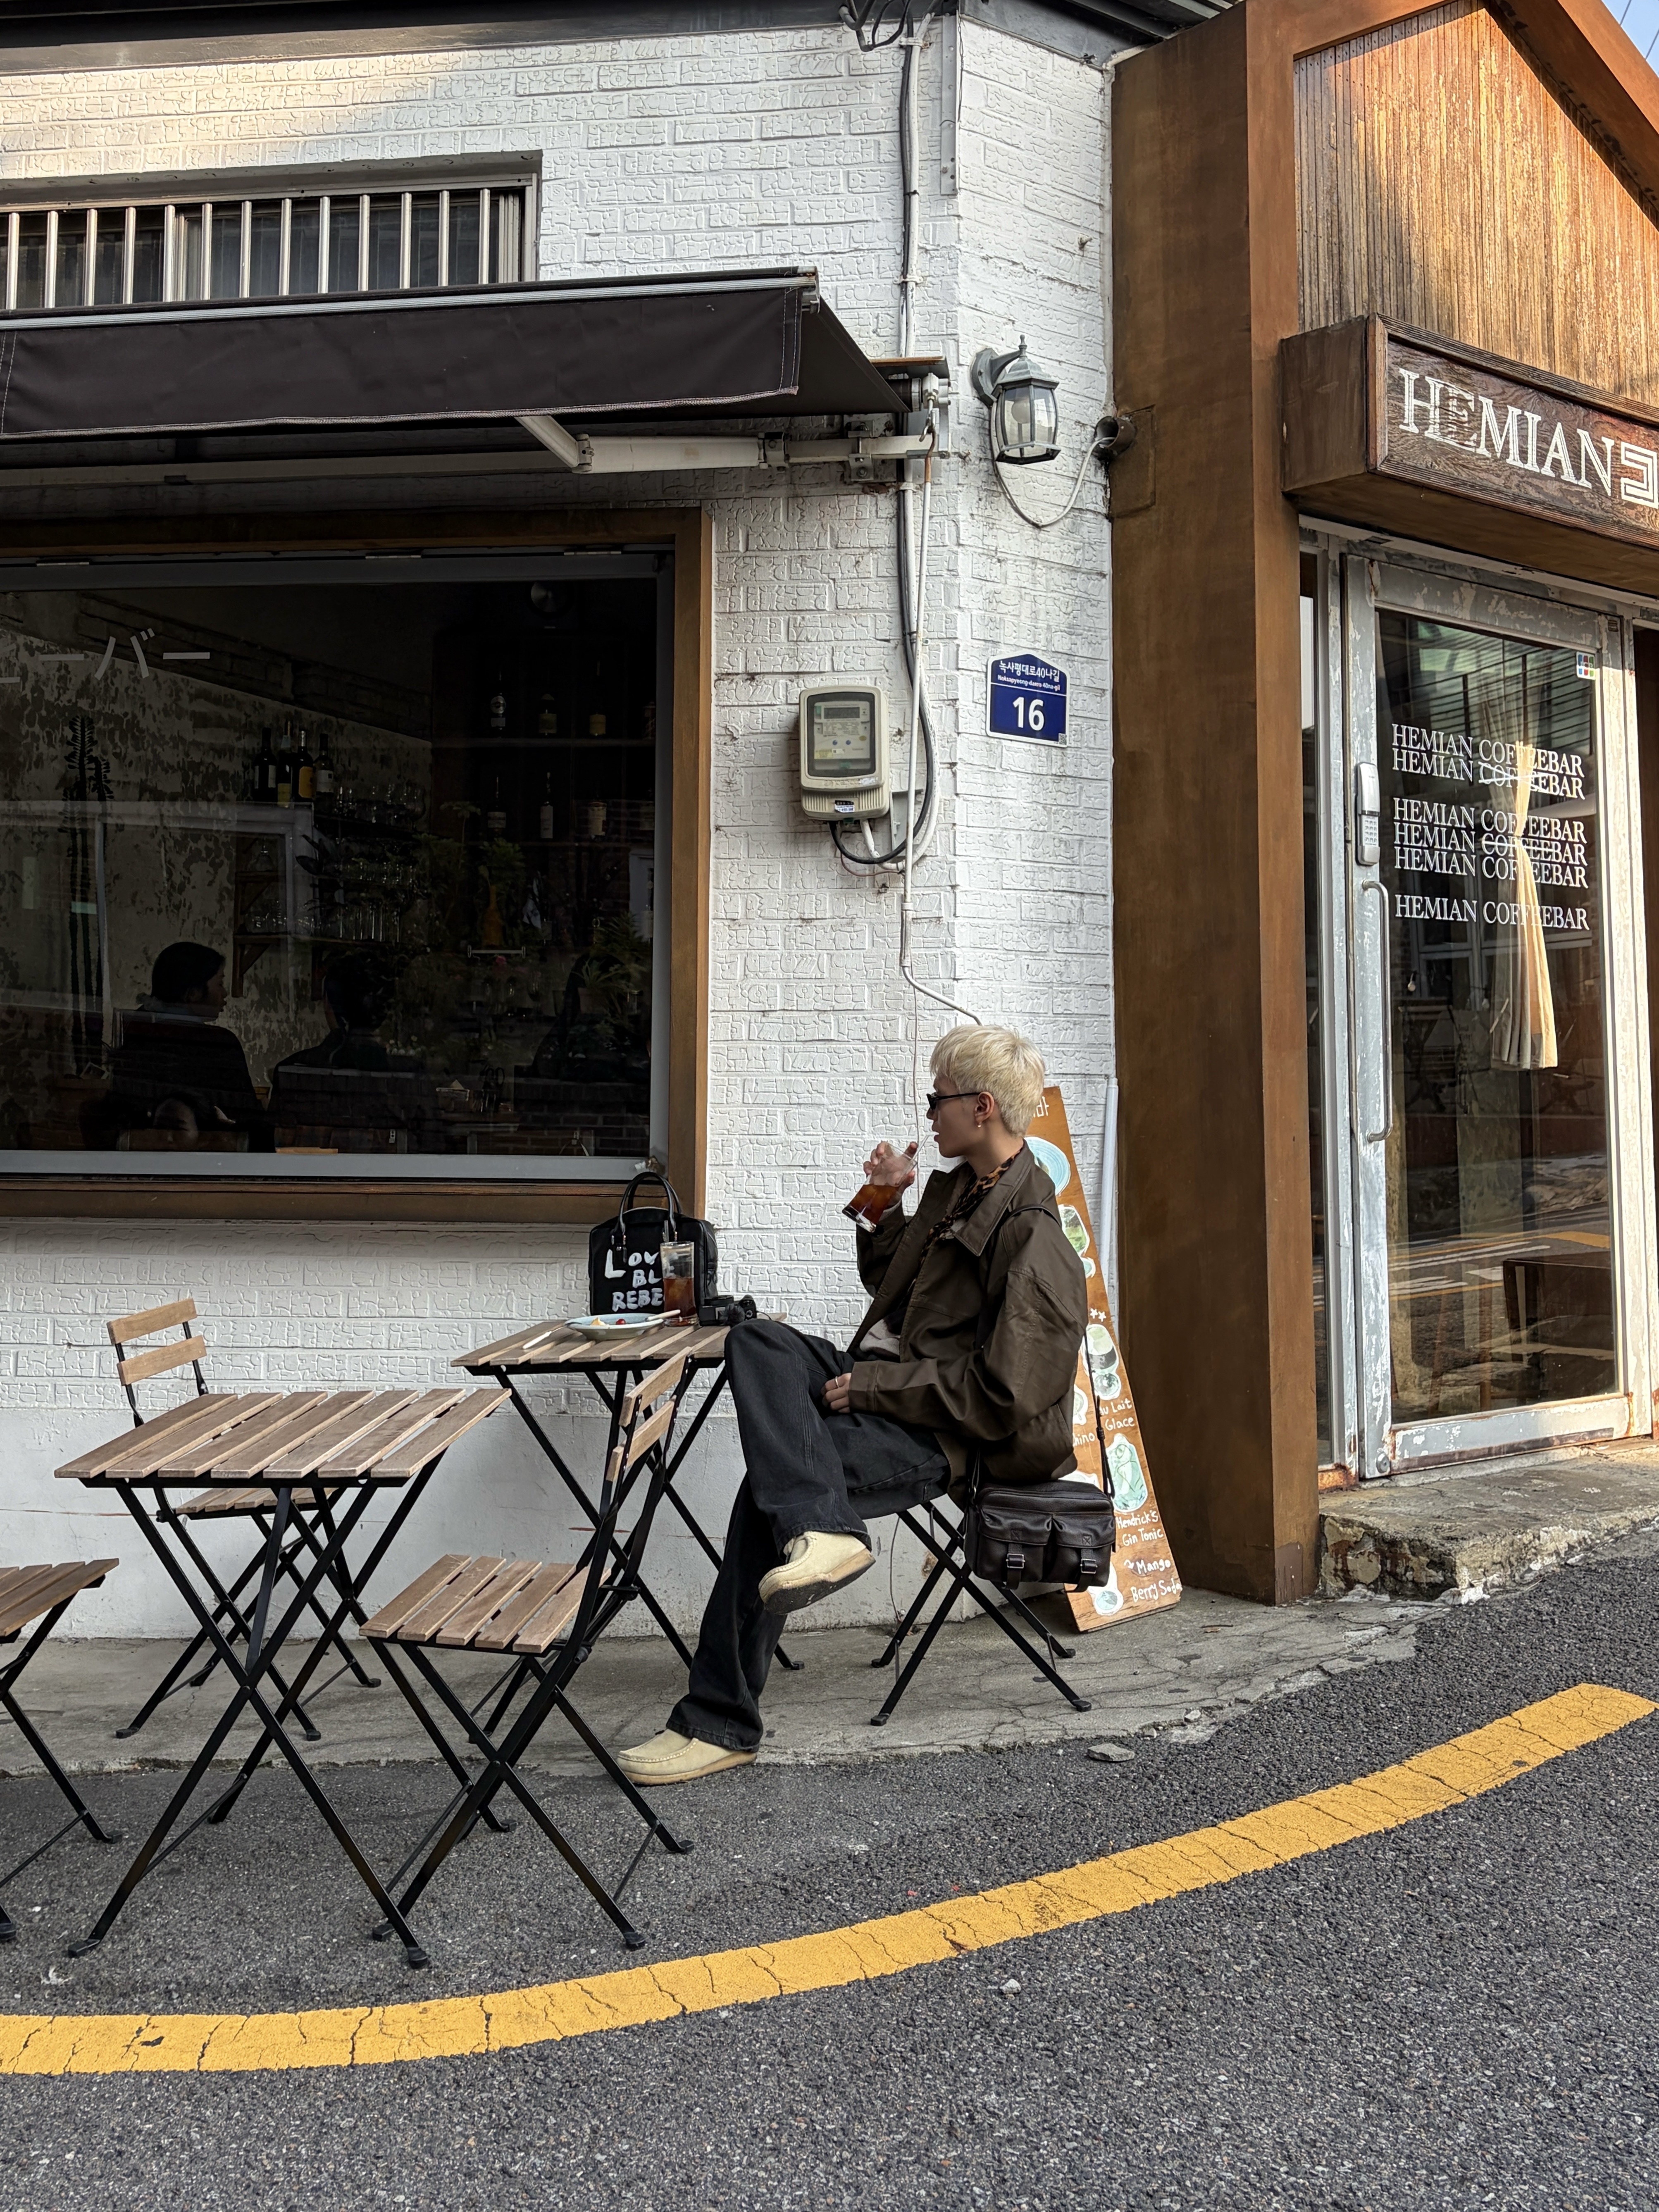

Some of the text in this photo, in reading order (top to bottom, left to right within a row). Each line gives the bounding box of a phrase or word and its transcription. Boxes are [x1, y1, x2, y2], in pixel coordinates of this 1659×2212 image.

[1399, 368, 1614, 496] HEMIAN
[999, 660, 1060, 682] 녹사평대로40나길
[1012, 696, 1044, 731] 16
[1391, 723, 1473, 759] HEMIAN
[1392, 748, 1585, 800] HEMIAN COFEEBAR
[1393, 797, 1587, 844] HEMIAN COFEEBAR
[1393, 822, 1475, 853] HEMIAN
[1394, 846, 1589, 889] HEMIAN COFEEBAR
[1395, 894, 1477, 923] HEMIAN
[632, 1269, 662, 1289] BL
[612, 1288, 663, 1312] REBE
[1110, 1398, 1132, 1413] Lait
[1105, 1416, 1135, 1431] Glace
[1073, 1432, 1095, 1447] hino
[1122, 1528, 1164, 1547] Gin Tonic
[1136, 1559, 1171, 1575] Mango
[1130, 1578, 1183, 1603] Berry Soda
